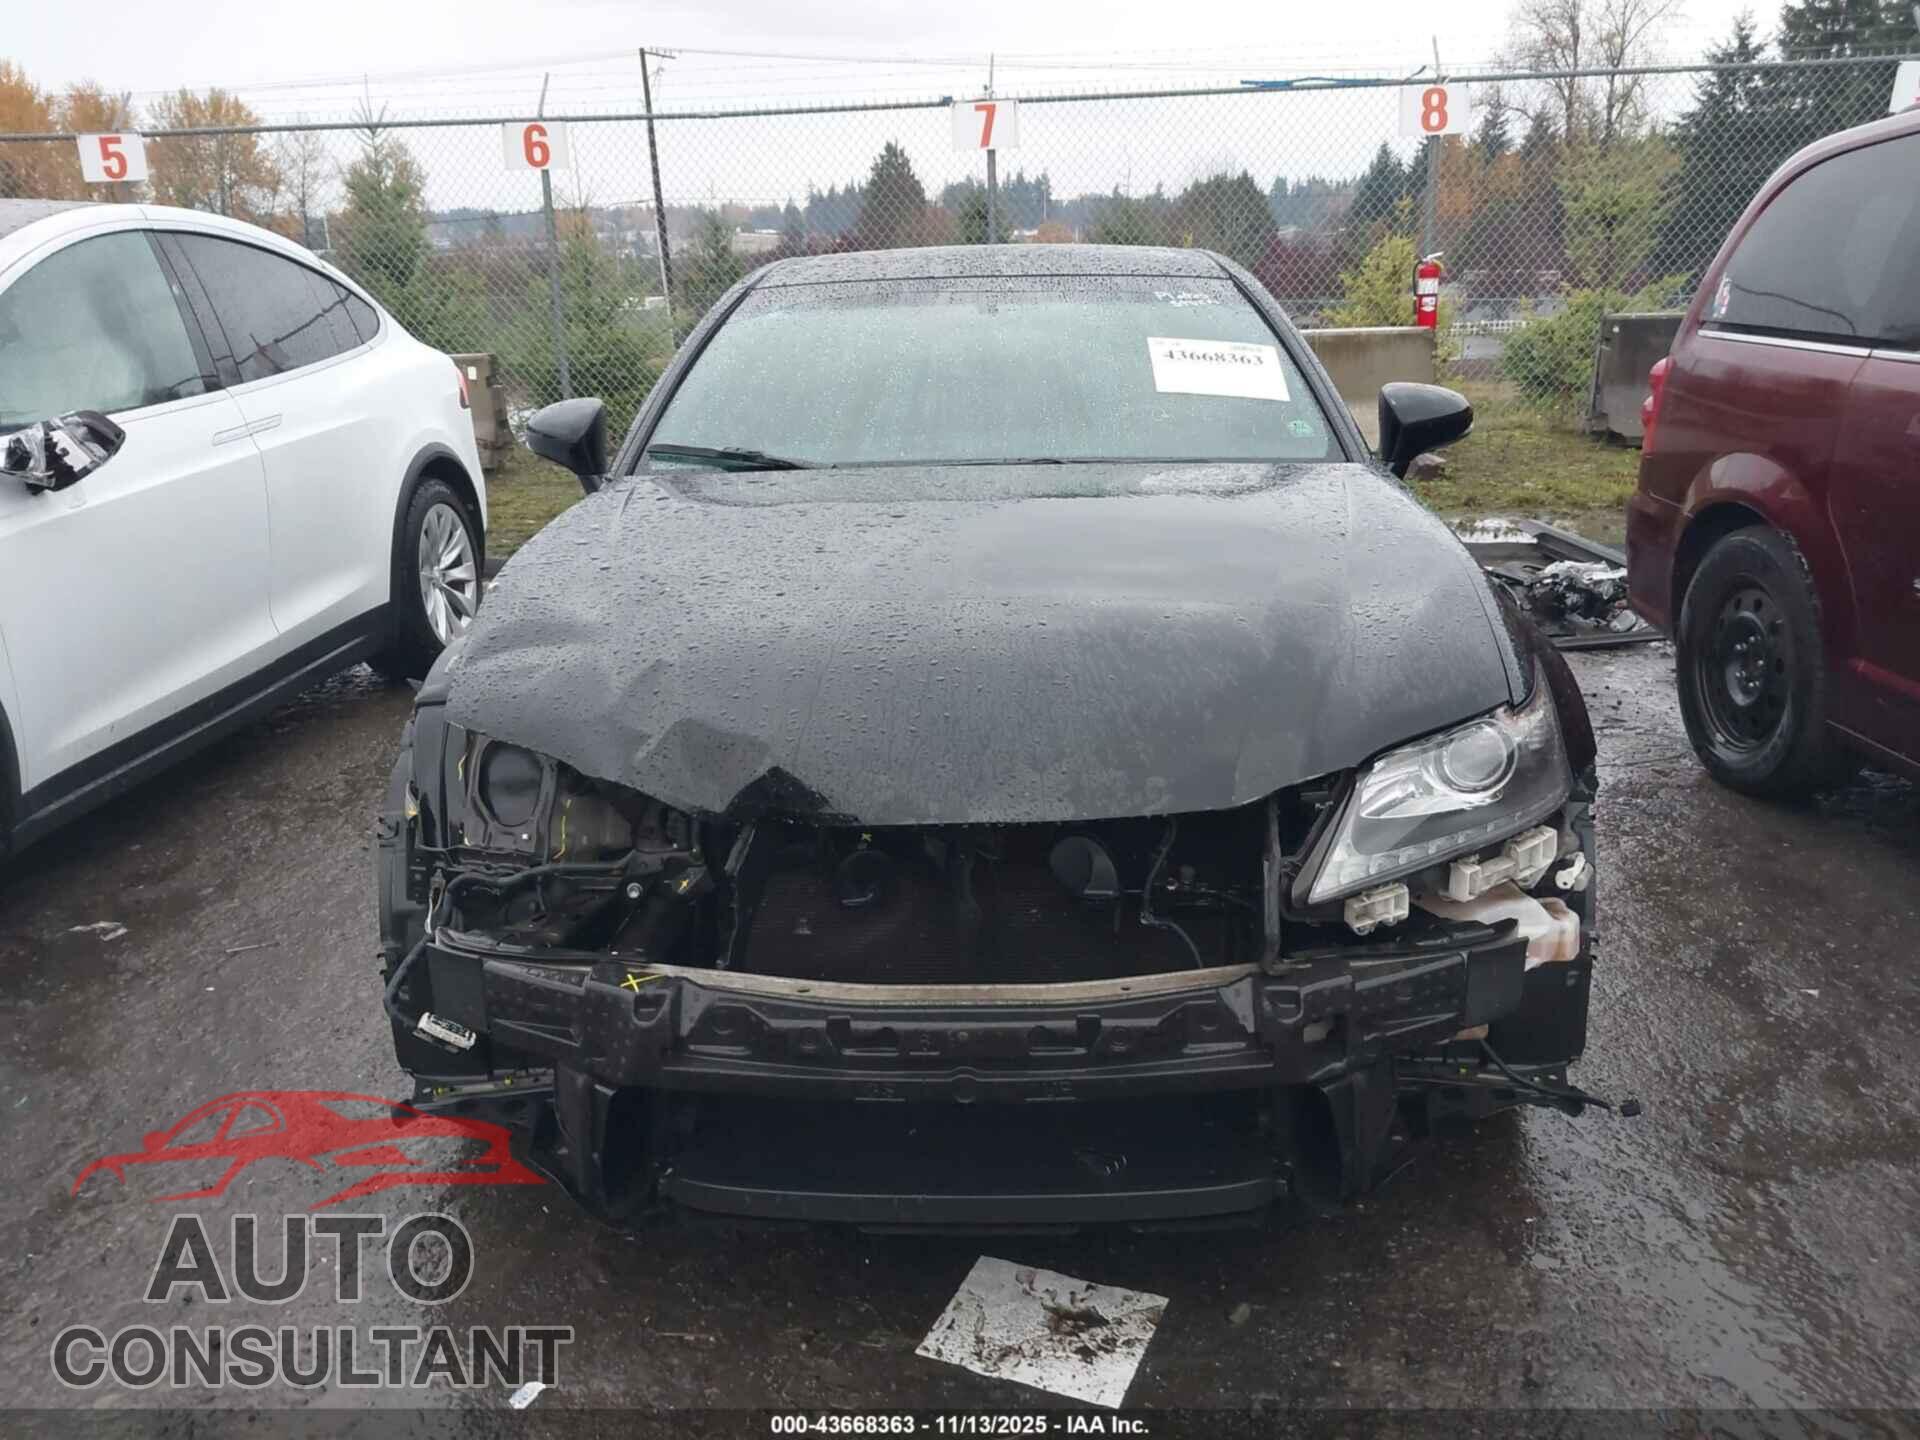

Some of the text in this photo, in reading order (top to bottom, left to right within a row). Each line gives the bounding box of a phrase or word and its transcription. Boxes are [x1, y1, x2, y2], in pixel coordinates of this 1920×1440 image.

[975, 103, 996, 148] 7
[1422, 87, 1448, 132] 8
[98, 136, 128, 179] 5
[523, 124, 550, 168] 6
[1163, 348, 1264, 366] 43668363
